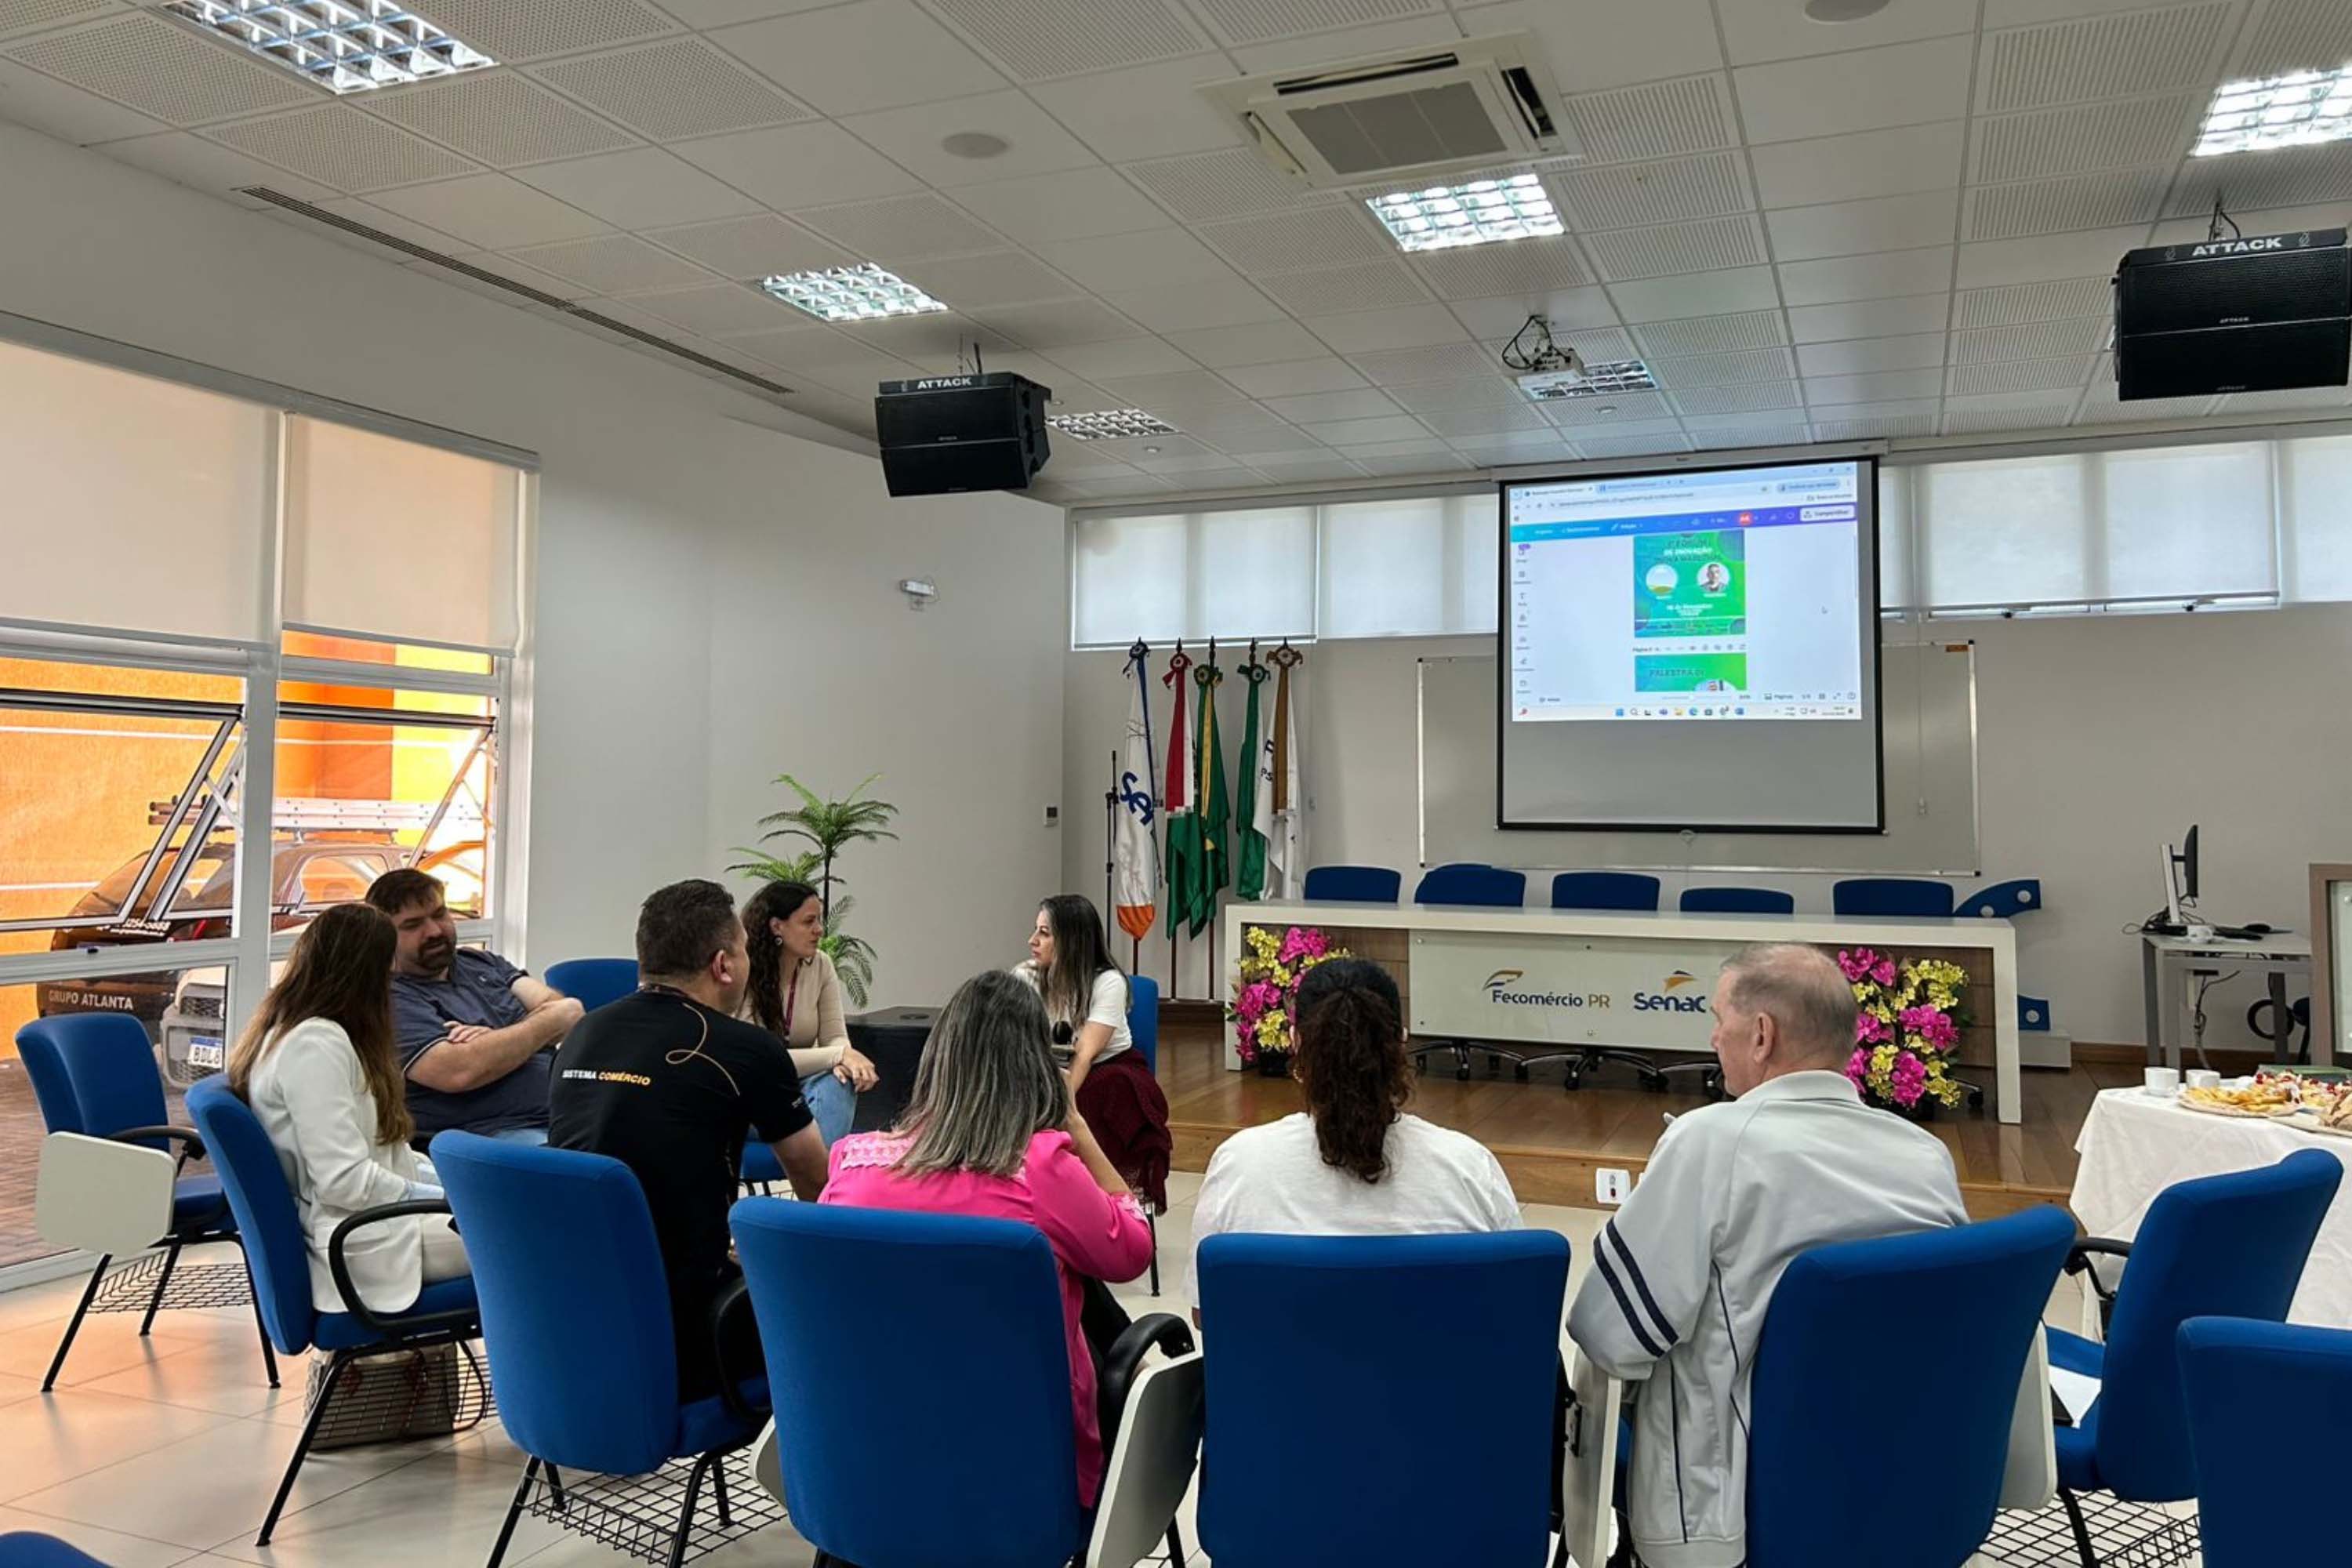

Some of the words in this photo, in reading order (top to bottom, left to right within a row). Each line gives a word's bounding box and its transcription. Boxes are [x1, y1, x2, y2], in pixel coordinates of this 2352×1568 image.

[2192, 238, 2282, 256] ATTACK
[917, 377, 972, 389] ATTACK
[49, 989, 78, 1004] GRUPO
[82, 993, 133, 1010] ATLANTA
[1492, 989, 1583, 1007] Fecomércio
[1588, 994, 1610, 1008] PR
[1634, 992, 1706, 1013] Senac
[562, 1069, 597, 1080] SISTEMA
[598, 1070, 651, 1086] COMÉRCIO
